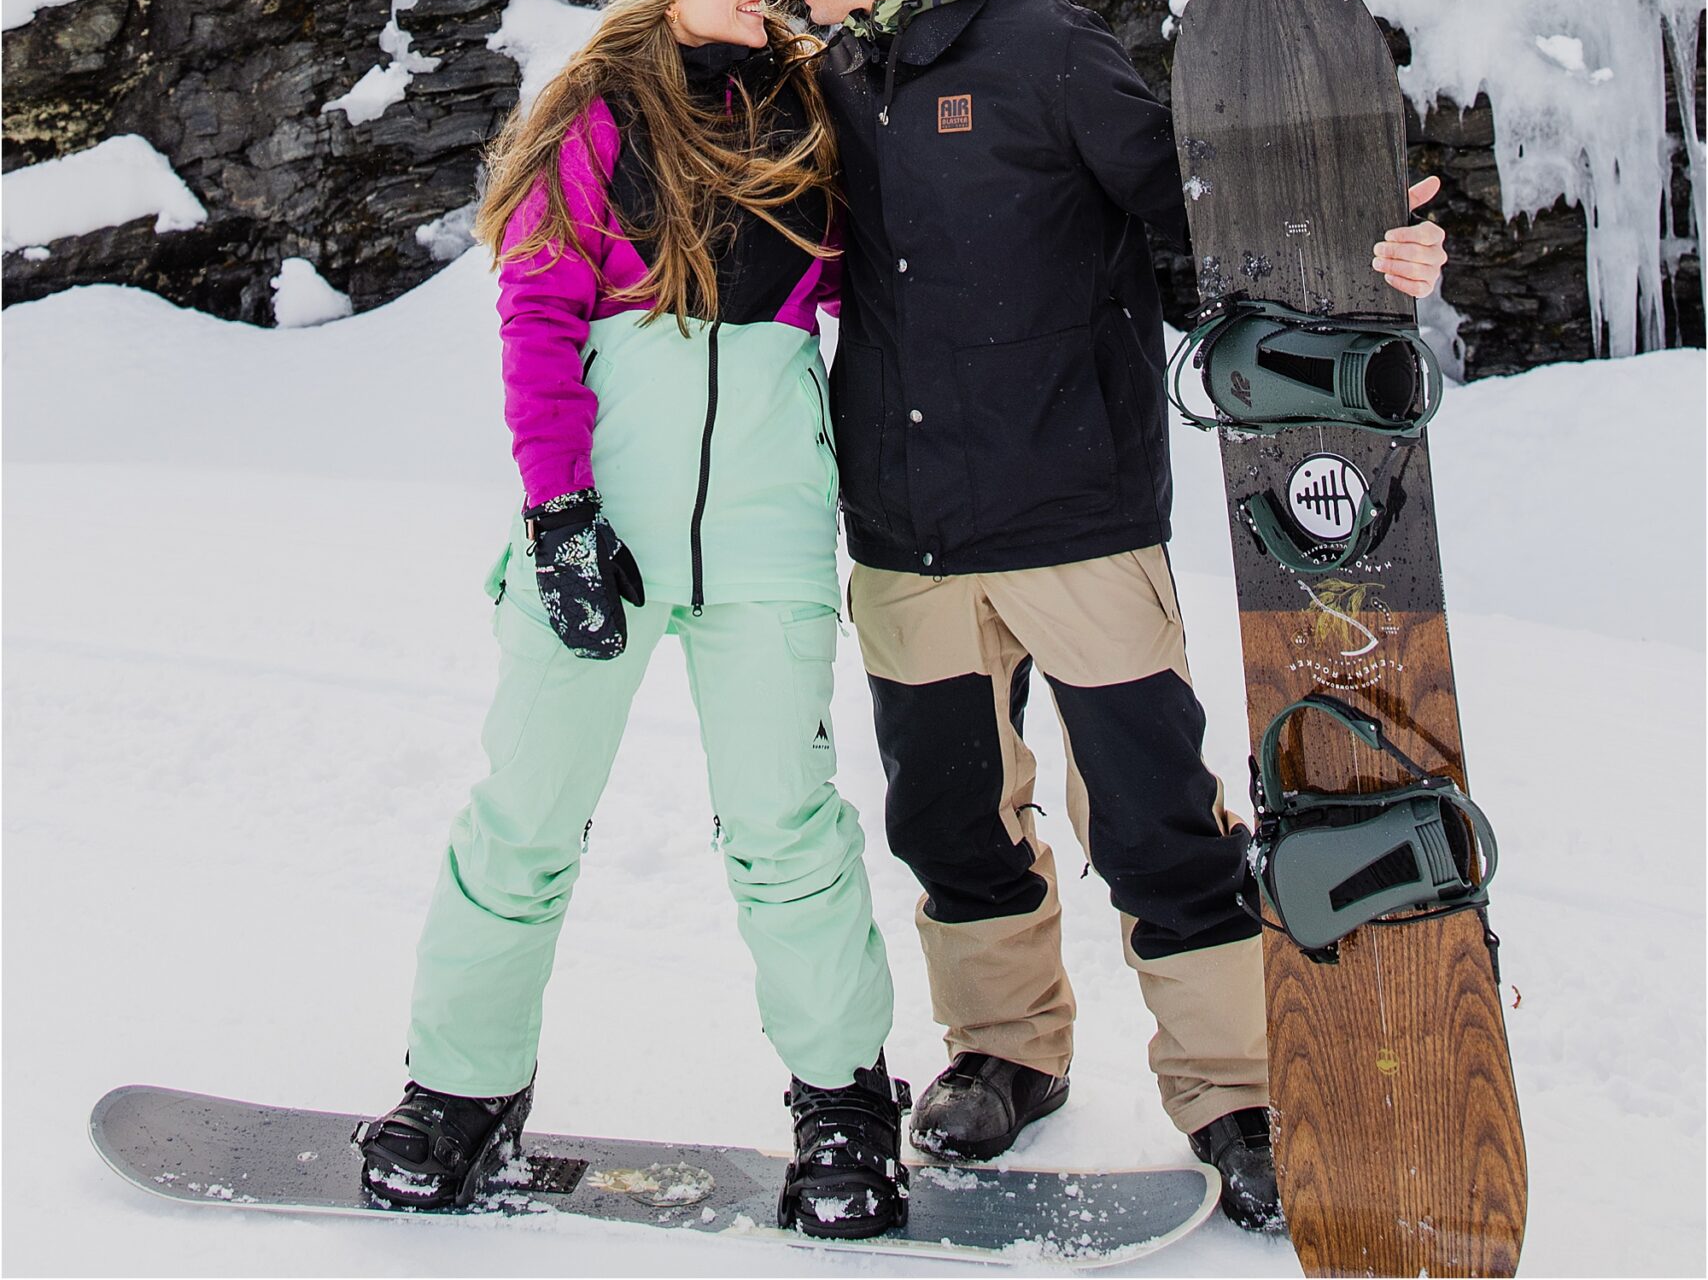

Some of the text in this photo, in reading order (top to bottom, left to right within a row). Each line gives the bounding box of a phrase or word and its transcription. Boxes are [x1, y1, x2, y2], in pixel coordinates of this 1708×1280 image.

[941, 98, 969, 117] AIR
[1230, 370, 1253, 408] K2
[1355, 560, 1392, 573] HAND
[1289, 659, 1404, 680] ELEMENT ROCKER
